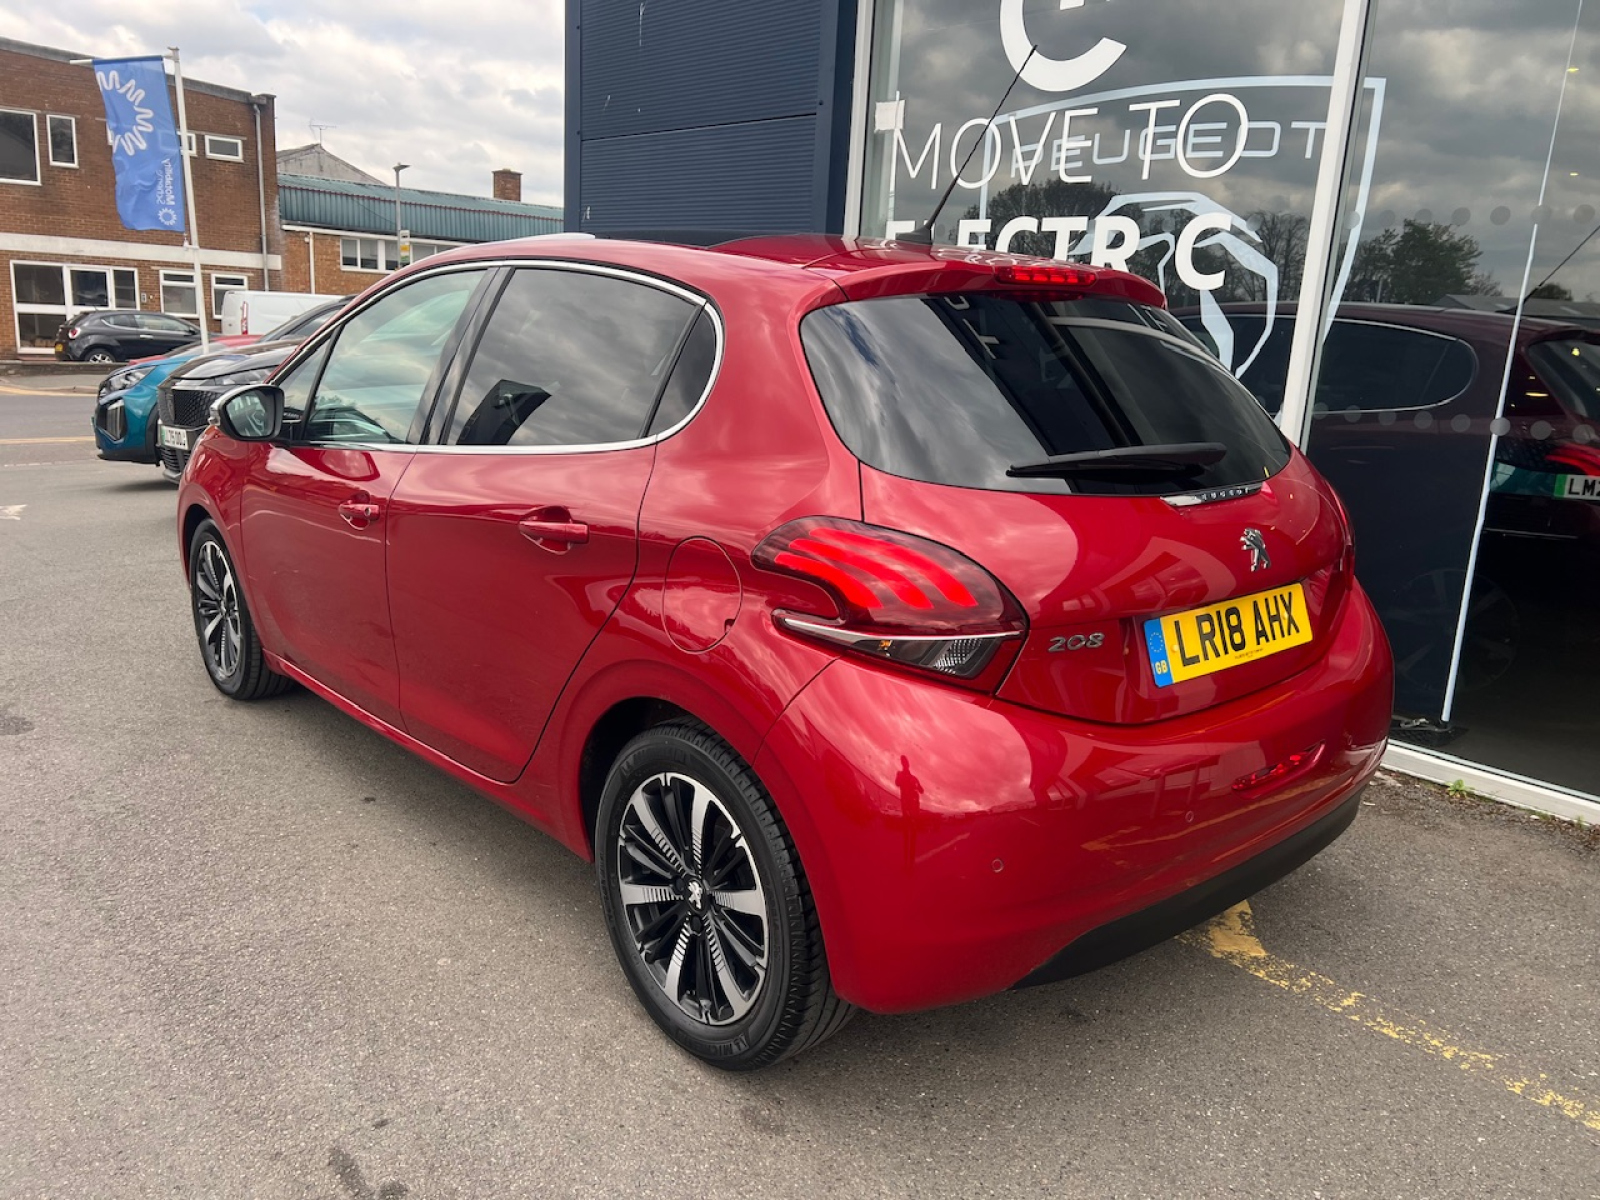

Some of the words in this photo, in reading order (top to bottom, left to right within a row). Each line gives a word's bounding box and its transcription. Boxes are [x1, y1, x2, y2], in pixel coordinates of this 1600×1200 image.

[891, 107, 1099, 191] MOVE
[1129, 93, 1250, 181] TO
[1048, 632, 1105, 653] 208
[1174, 606, 1246, 667] LR18
[1253, 591, 1300, 646] AHX
[1155, 659, 1169, 675] GB
